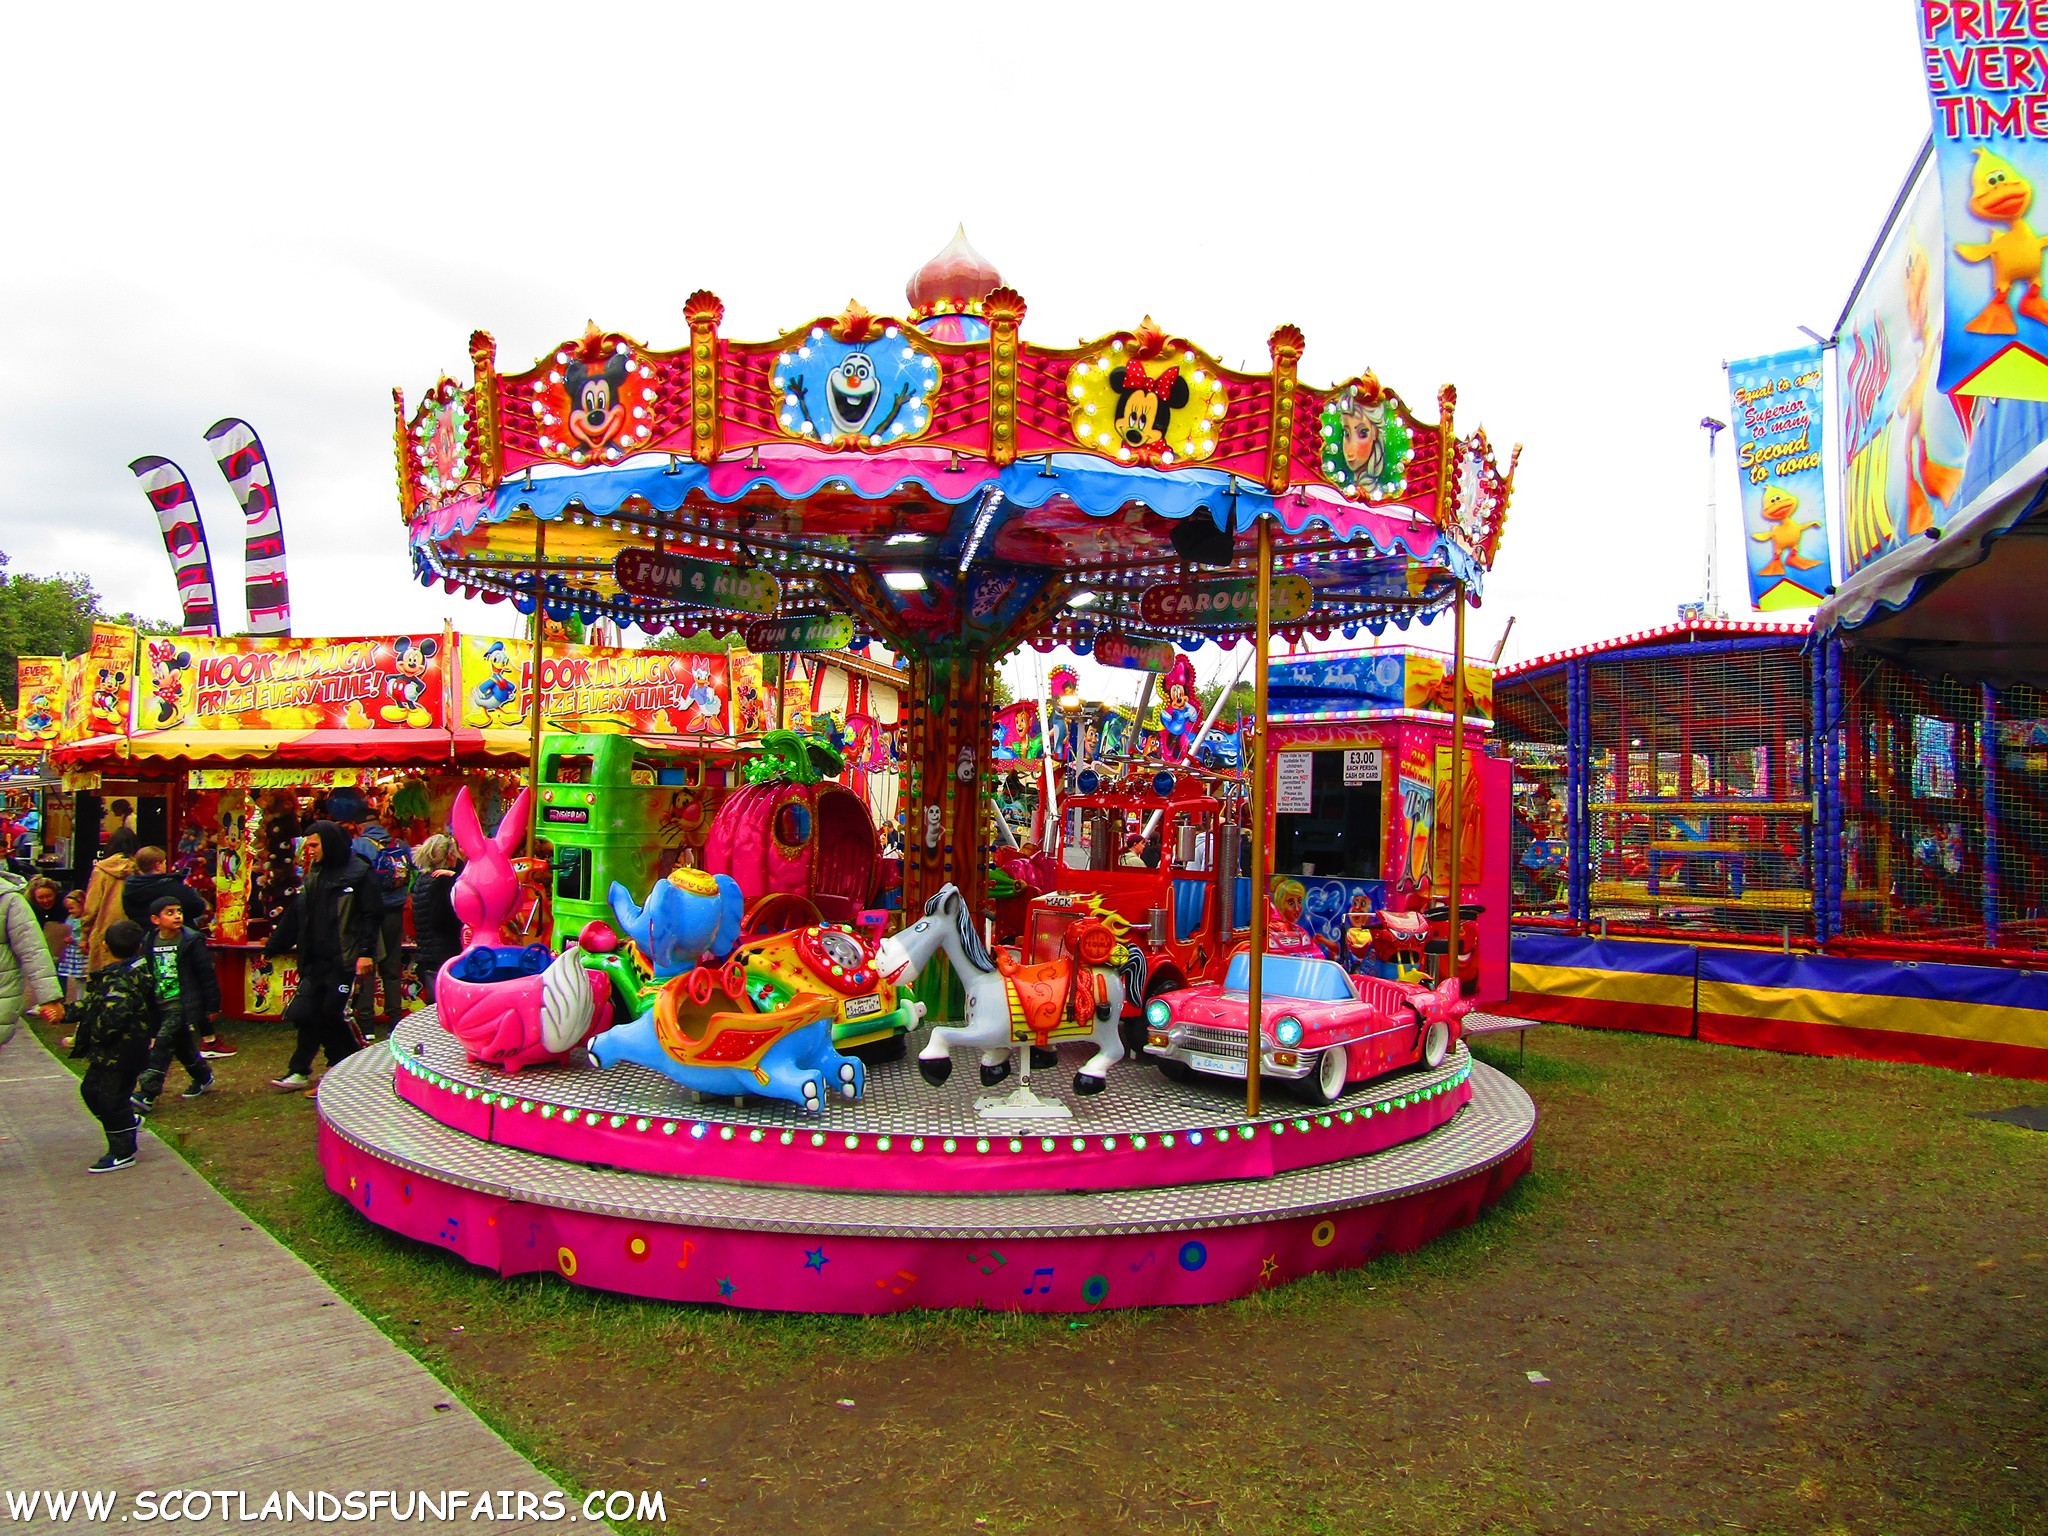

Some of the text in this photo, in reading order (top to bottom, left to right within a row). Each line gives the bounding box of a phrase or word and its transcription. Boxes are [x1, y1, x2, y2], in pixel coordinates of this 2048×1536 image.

[1922, 0, 2048, 42] PRIZE
[1924, 45, 2048, 94] EVERY
[1936, 95, 2048, 139] TIME
[1734, 371, 1821, 406] Equal to any
[1745, 399, 1805, 427] Superior
[1753, 414, 1810, 438] to many
[1739, 430, 1810, 469] Second
[1749, 451, 1820, 485] to none
[229, 447, 290, 624] COFFE
[637, 562, 763, 600] FUN 4 KIDS
[758, 624, 841, 643] FUN 4 KIDS
[1104, 642, 1166, 659] CAROUSEL
[198, 641, 380, 689] HOOK A DUCK
[520, 655, 677, 691] HOOK A DUCK
[197, 670, 384, 716] PRIZE EVERY TIME!
[577, 688, 633, 714] EVERY
[634, 684, 684, 710] TIME!
[1350, 752, 1374, 764] £3.00
[1046, 898, 1071, 907] MACK
[1204, 1059, 1224, 1070] Elvis
